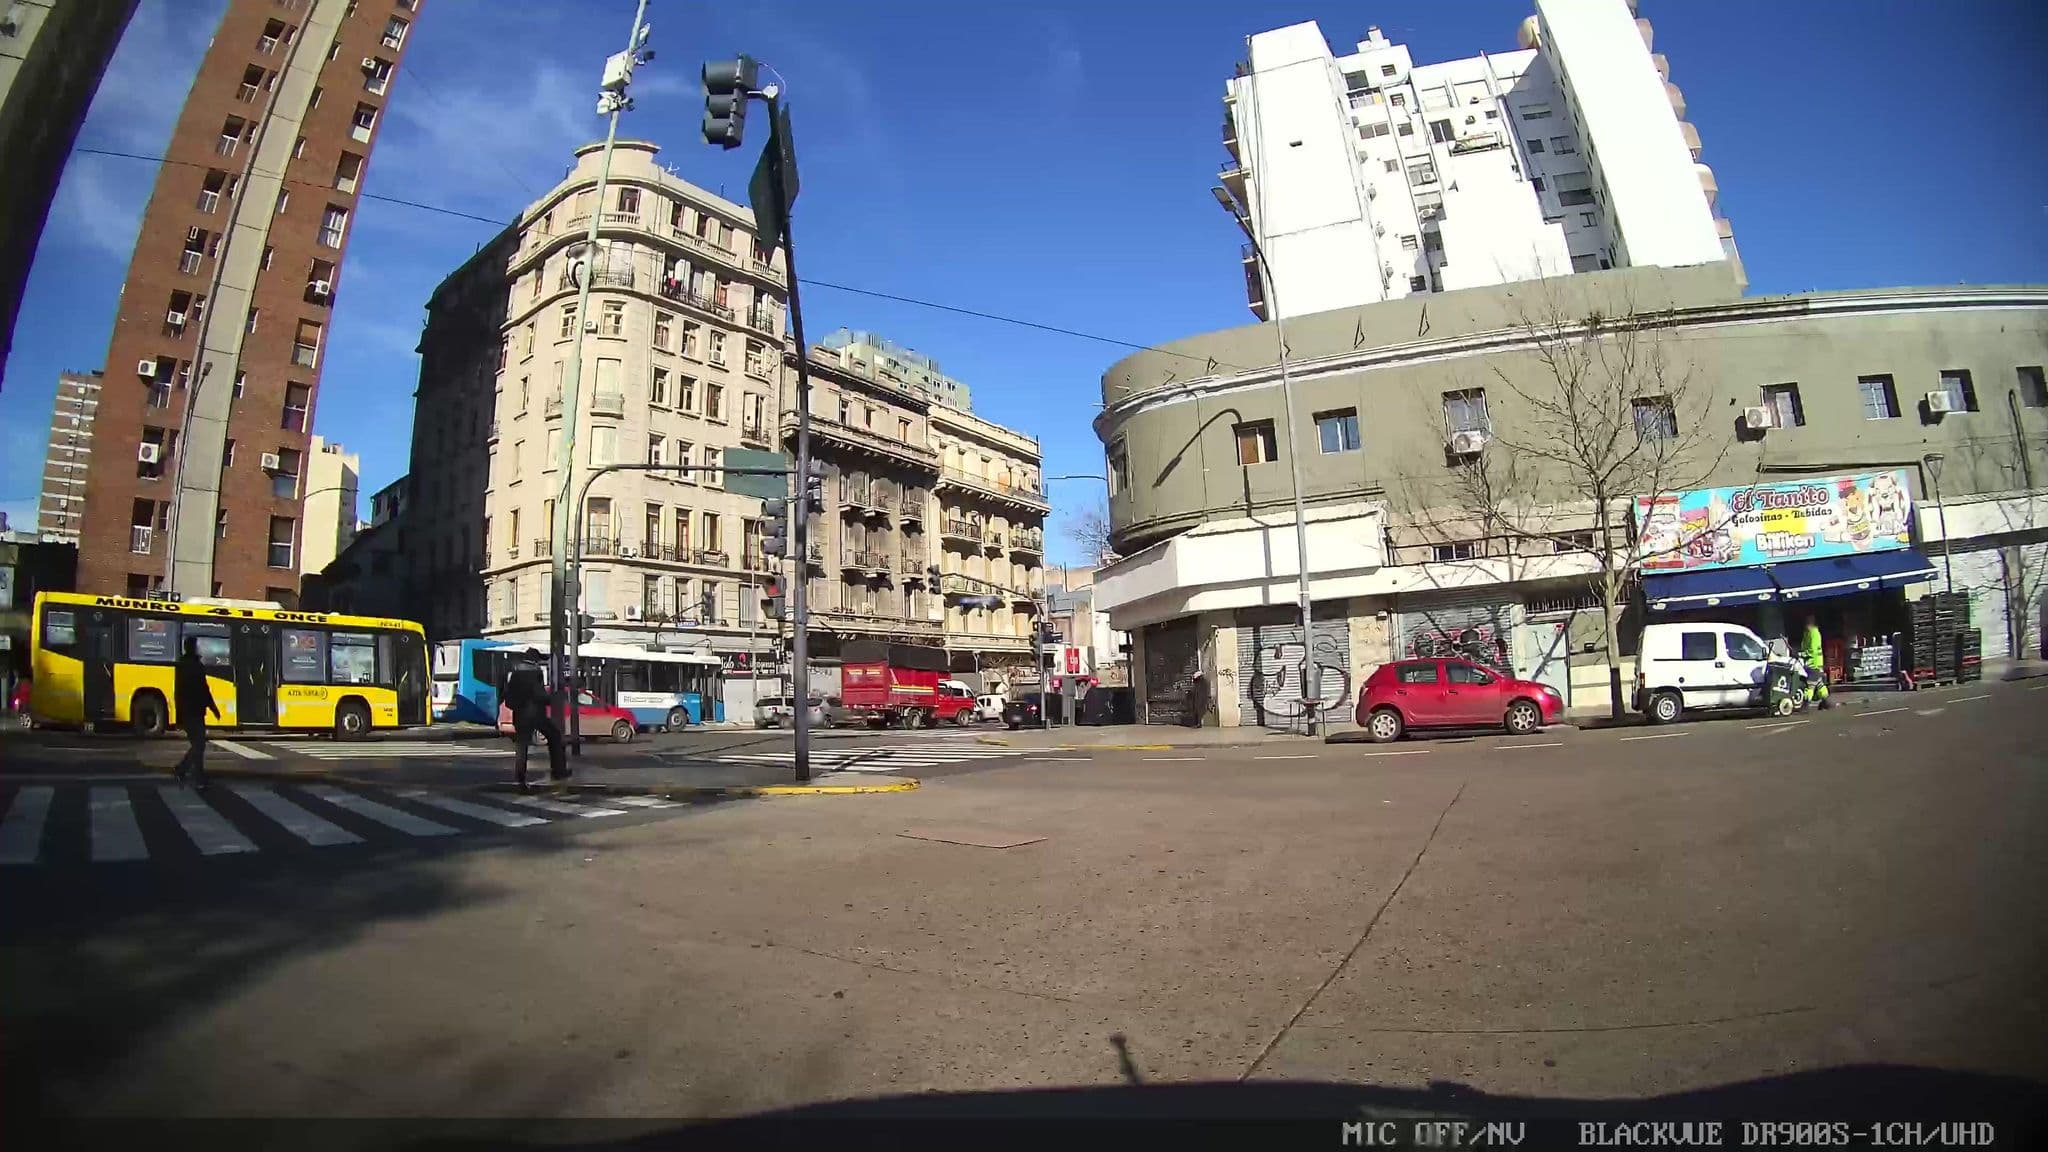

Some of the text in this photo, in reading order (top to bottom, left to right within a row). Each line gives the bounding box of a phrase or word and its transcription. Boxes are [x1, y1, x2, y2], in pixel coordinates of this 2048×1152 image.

[1732, 486, 1829, 512] El Tanito
[1731, 513, 1783, 527] Golosinas
[1756, 530, 1815, 552] Billiken
[96, 597, 328, 622] MUNRO 41 ONCE
